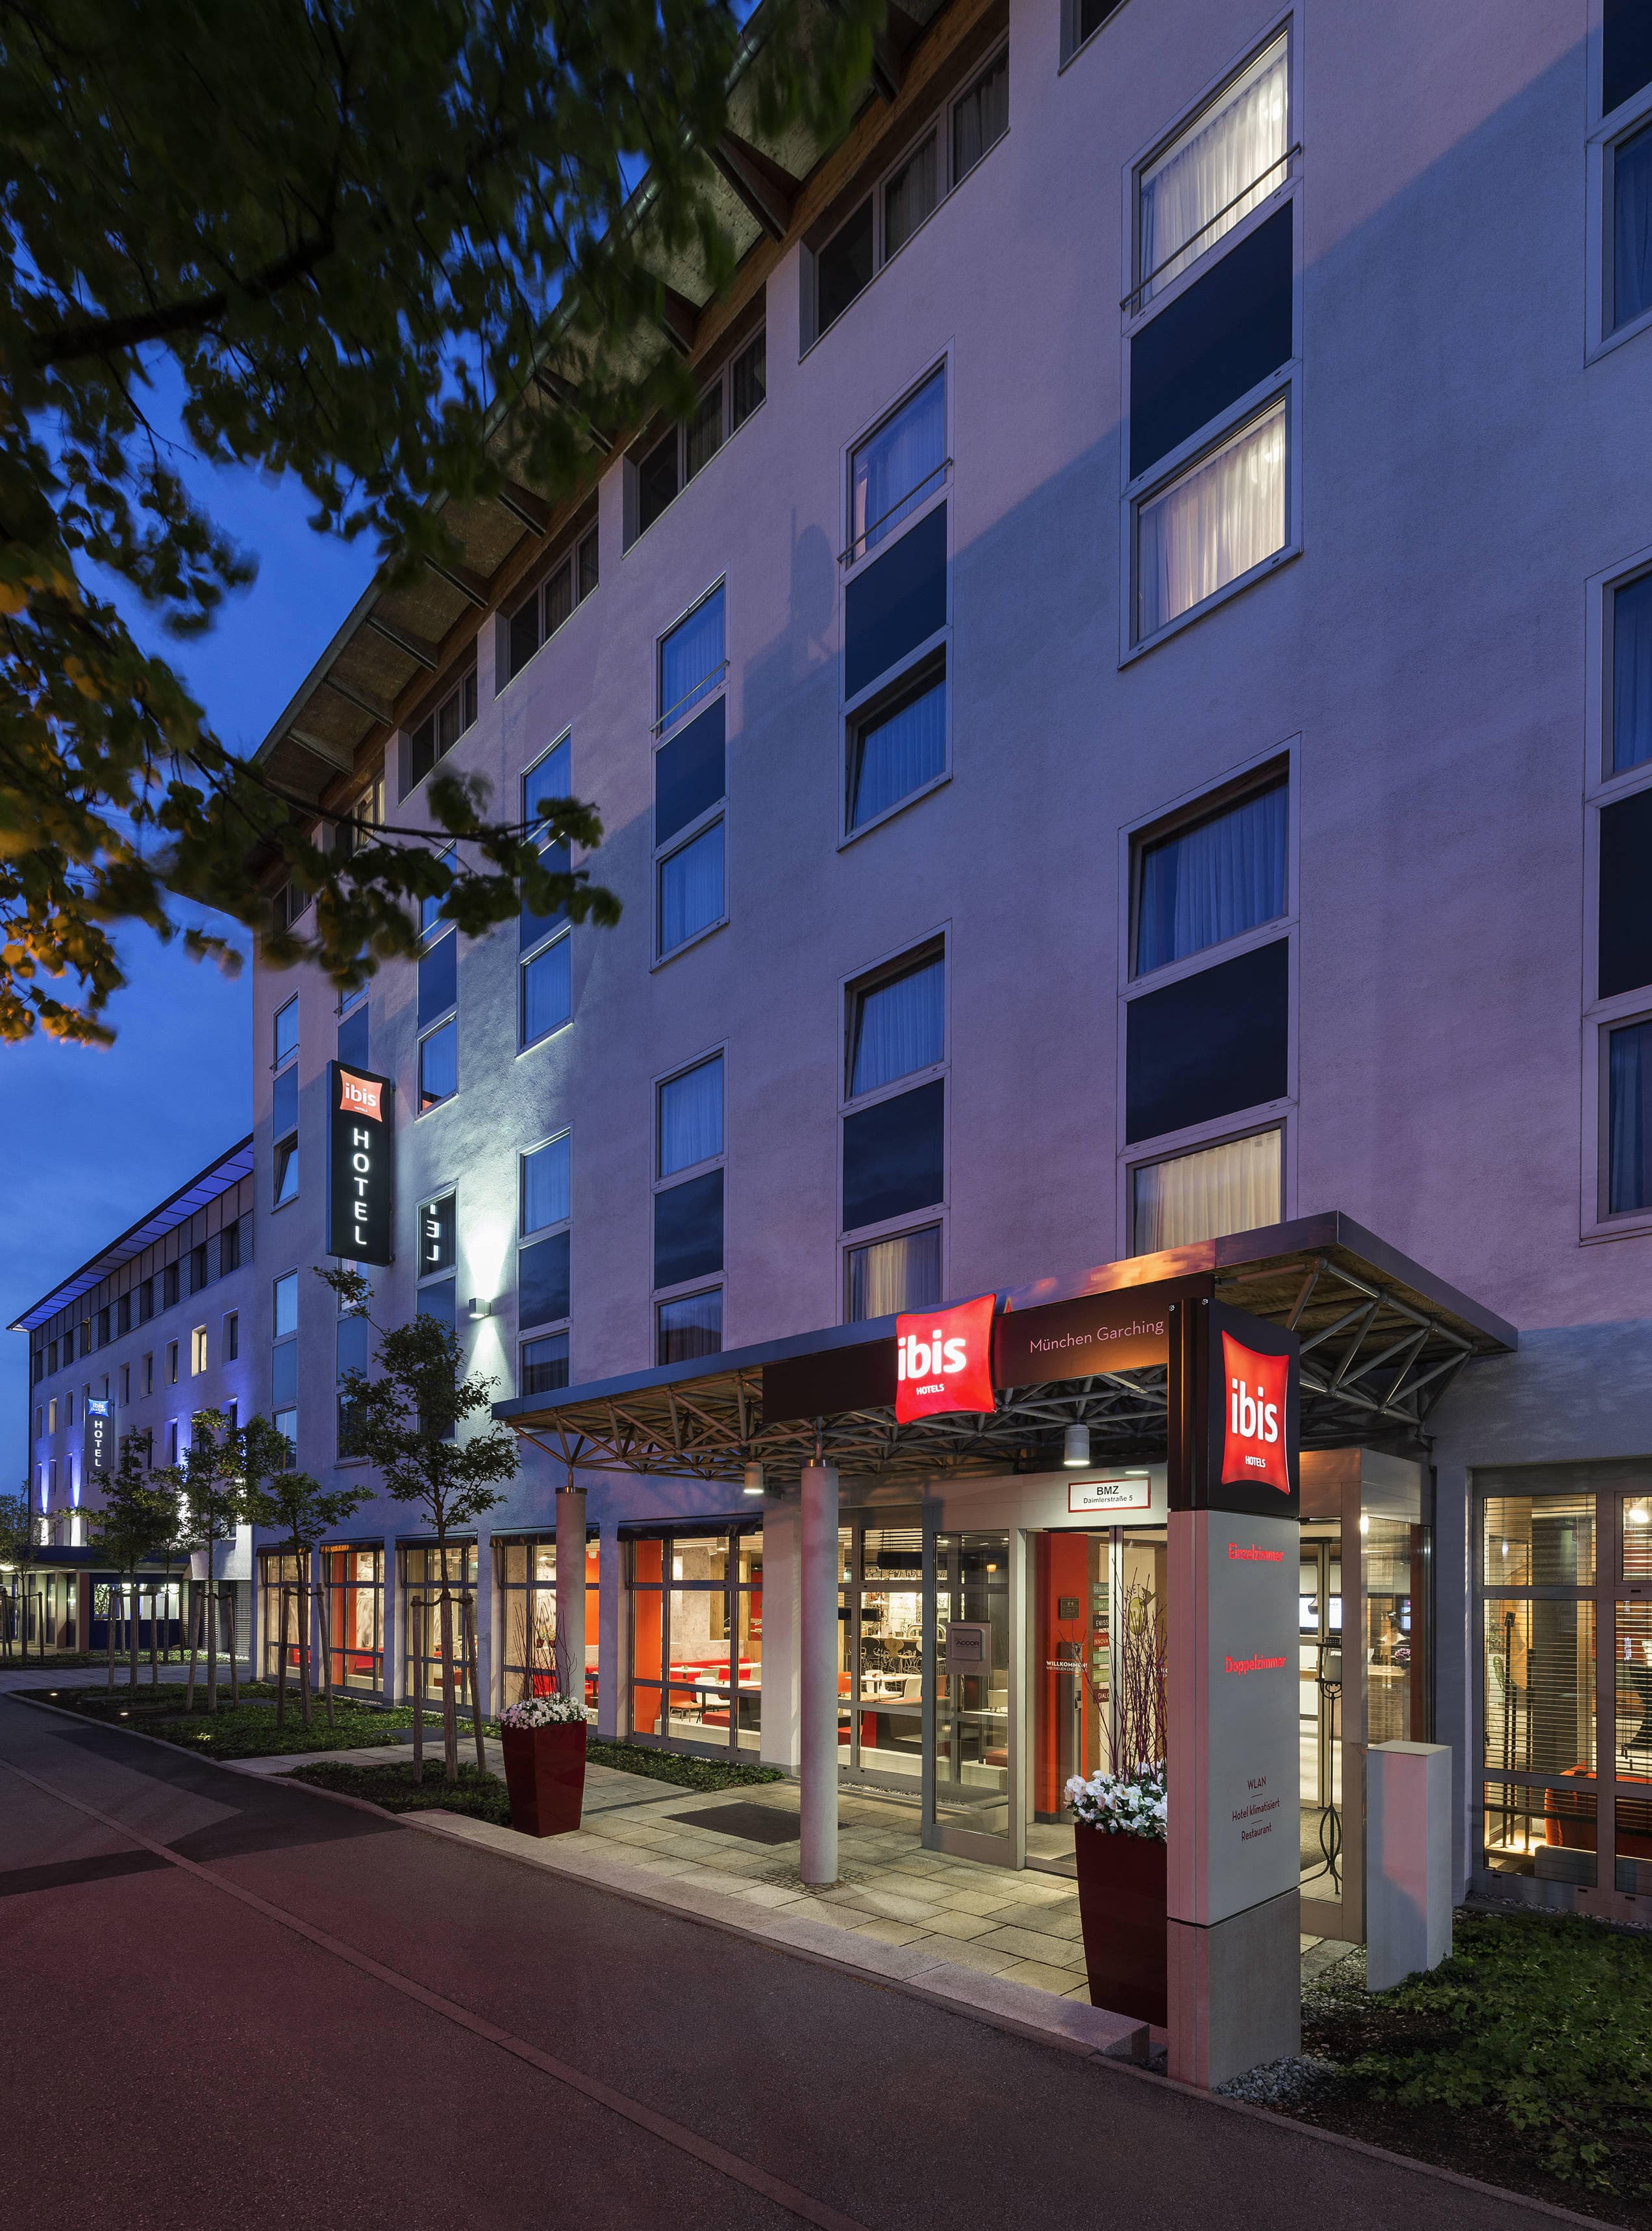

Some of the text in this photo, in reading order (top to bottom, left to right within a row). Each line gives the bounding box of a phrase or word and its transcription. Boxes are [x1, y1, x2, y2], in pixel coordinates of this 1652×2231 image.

[345, 1082, 377, 1107] ibis
[353, 1128, 370, 1245] HOTEL
[1030, 1320, 1164, 1353] München Garching
[898, 1330, 967, 1381] ibis
[916, 1383, 945, 1395] HOTELS
[1231, 1378, 1278, 1443] ibis
[94, 1420, 103, 1467] HOTEL
[1245, 1456, 1266, 1468] HOTELS
[1097, 1485, 1119, 1495] BMZ
[1228, 1543, 1284, 1562] Einzelzimmer
[1225, 1653, 1287, 1676] Doppelzimmer
[1247, 1776, 1266, 1790] WLAN
[1232, 1798, 1280, 1821] Hotel klimatisiert
[1241, 1822, 1271, 1841] Restaurant
